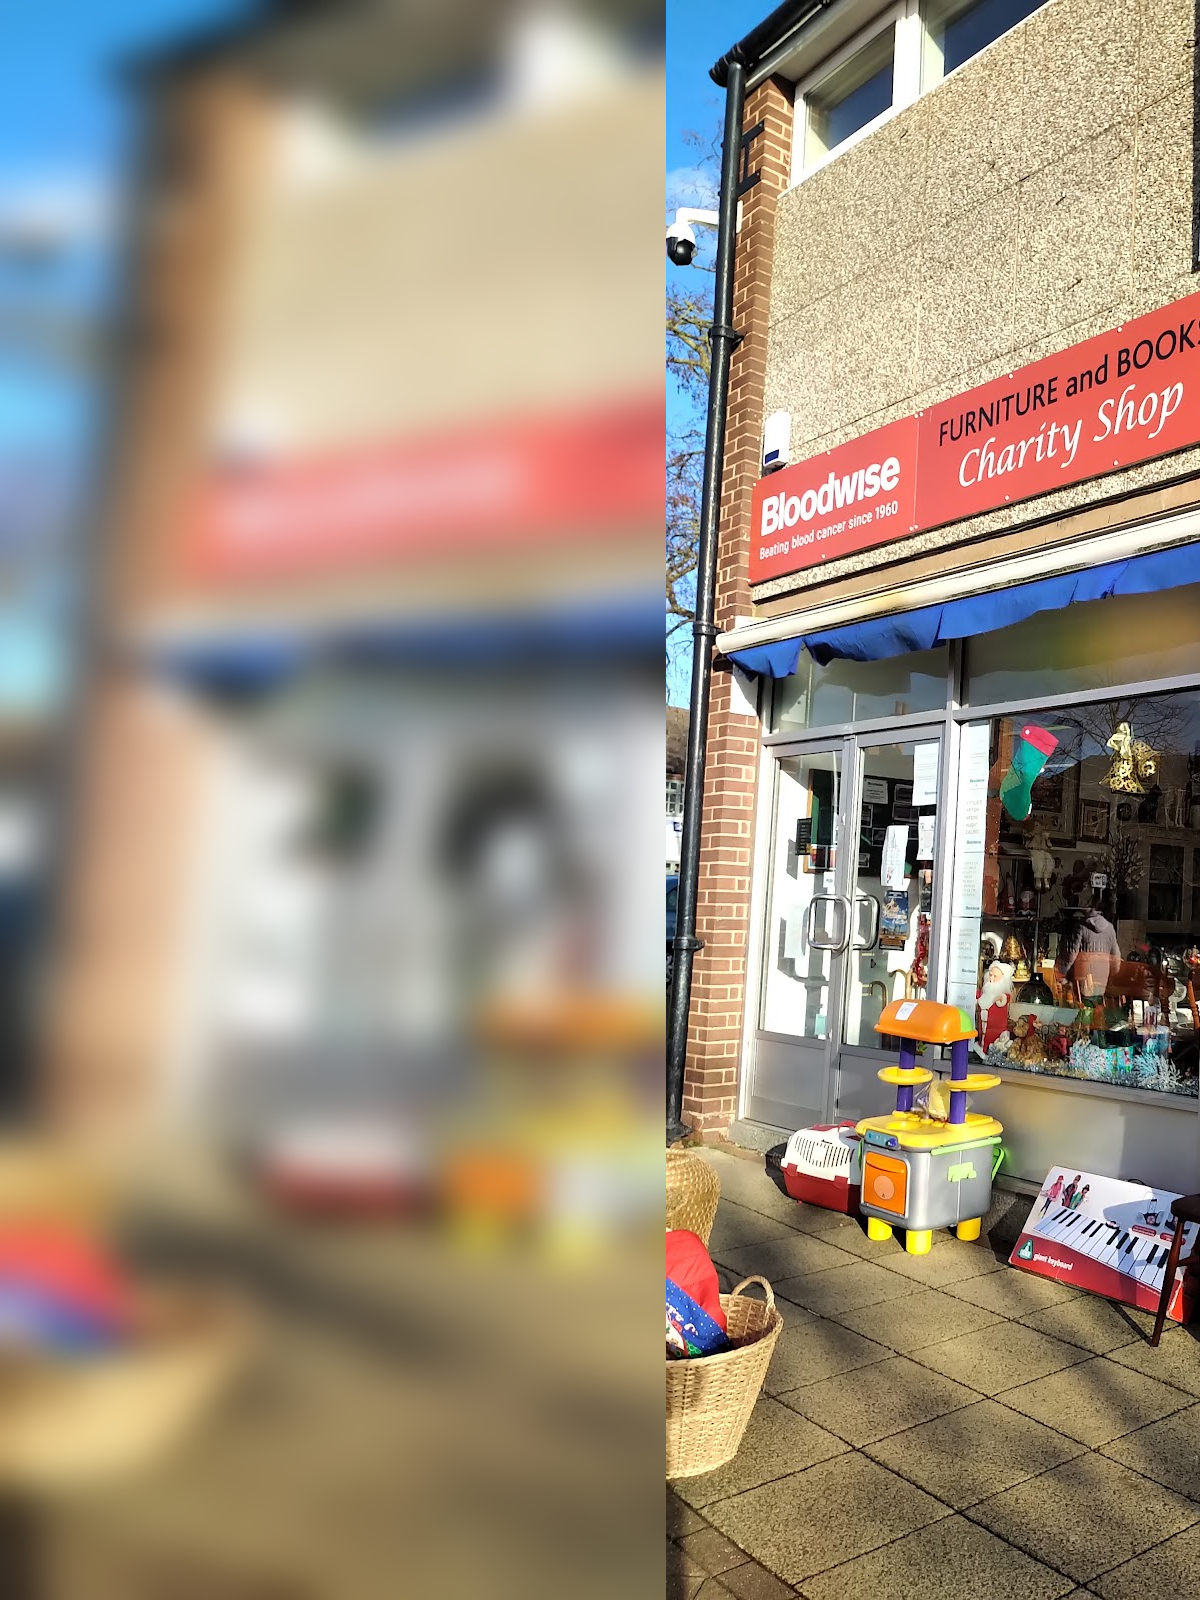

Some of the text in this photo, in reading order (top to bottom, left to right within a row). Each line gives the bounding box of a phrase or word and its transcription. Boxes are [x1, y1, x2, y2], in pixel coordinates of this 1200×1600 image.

[938, 376, 1058, 447] FURNITURE
[1065, 354, 1109, 397] and
[958, 381, 1184, 488] Charity Shop
[759, 500, 899, 560] Beating blood cancer since 1960
[760, 456, 901, 537] Bloodwise
[1033, 1253, 1047, 1262] giant
[1048, 1256, 1073, 1270] keyboard
